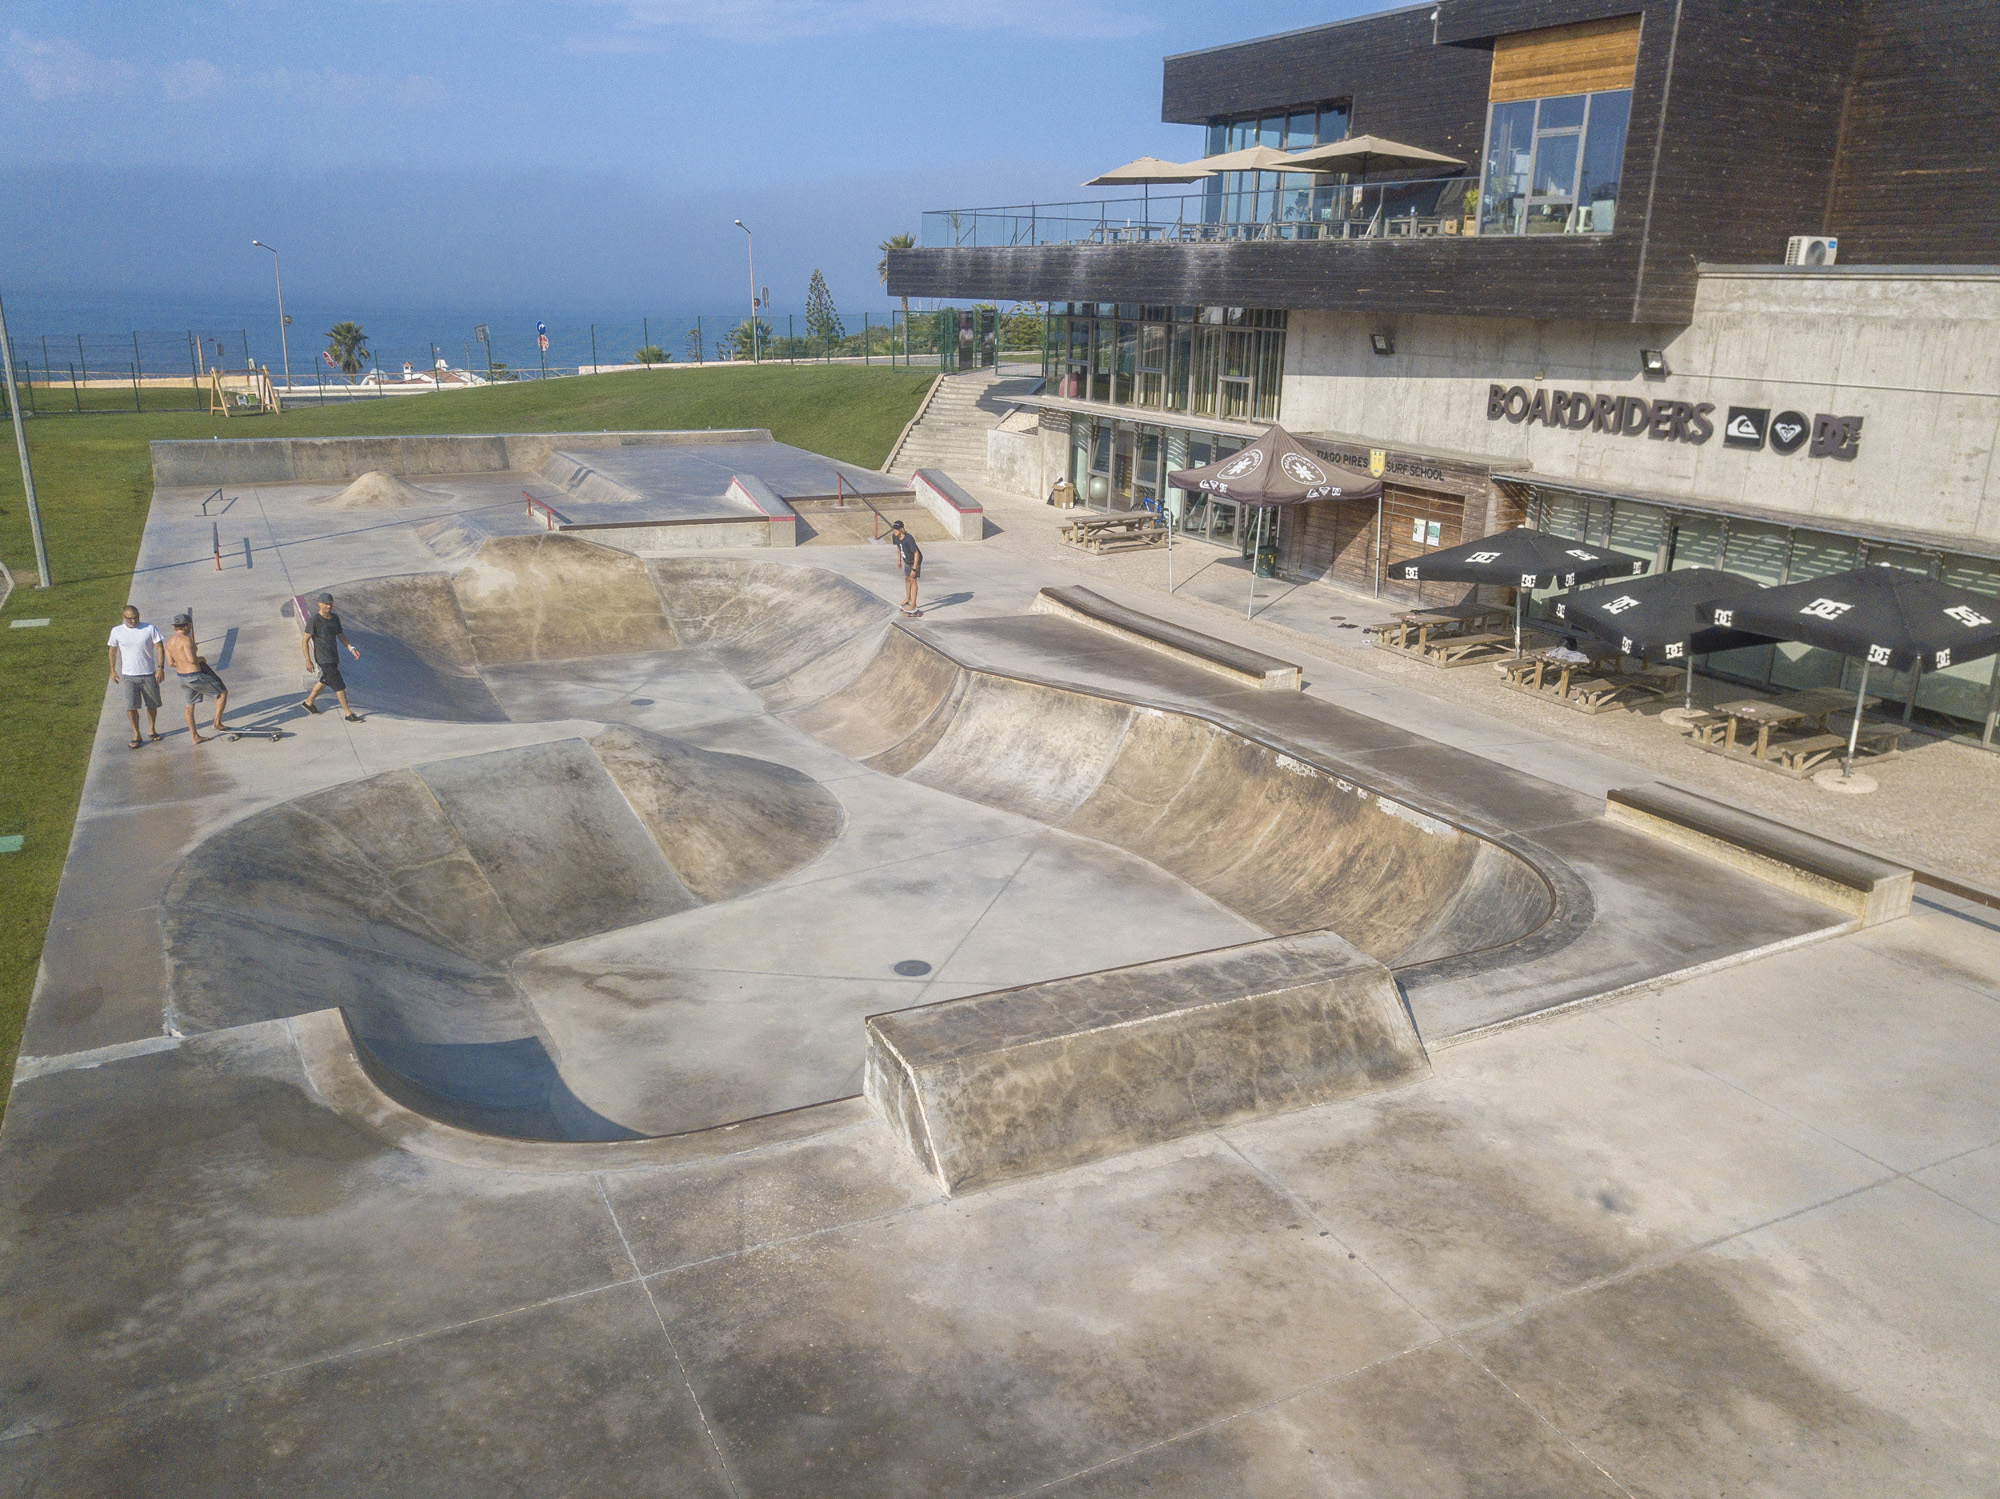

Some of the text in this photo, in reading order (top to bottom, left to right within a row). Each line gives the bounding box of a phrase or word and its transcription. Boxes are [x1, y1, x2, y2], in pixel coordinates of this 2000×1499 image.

[1487, 384, 1716, 446] BOARDRIDERS
[1808, 413, 1864, 462] DC
[1316, 450, 1341, 464] TIAGO
[1343, 454, 1369, 468] PIRES
[1386, 461, 1445, 481] SURF SCHOOL
[1464, 551, 1502, 563] DC
[1405, 566, 1419, 580] DC
[1521, 574, 1537, 588] DC
[1564, 572, 1576, 587] DC
[1714, 608, 1734, 627] DC
[1801, 598, 1853, 620] DC
[1621, 635, 1633, 655] DC
[1665, 641, 1684, 660] DC
[1867, 644, 1892, 666] DC
[1935, 648, 1951, 670] DC
